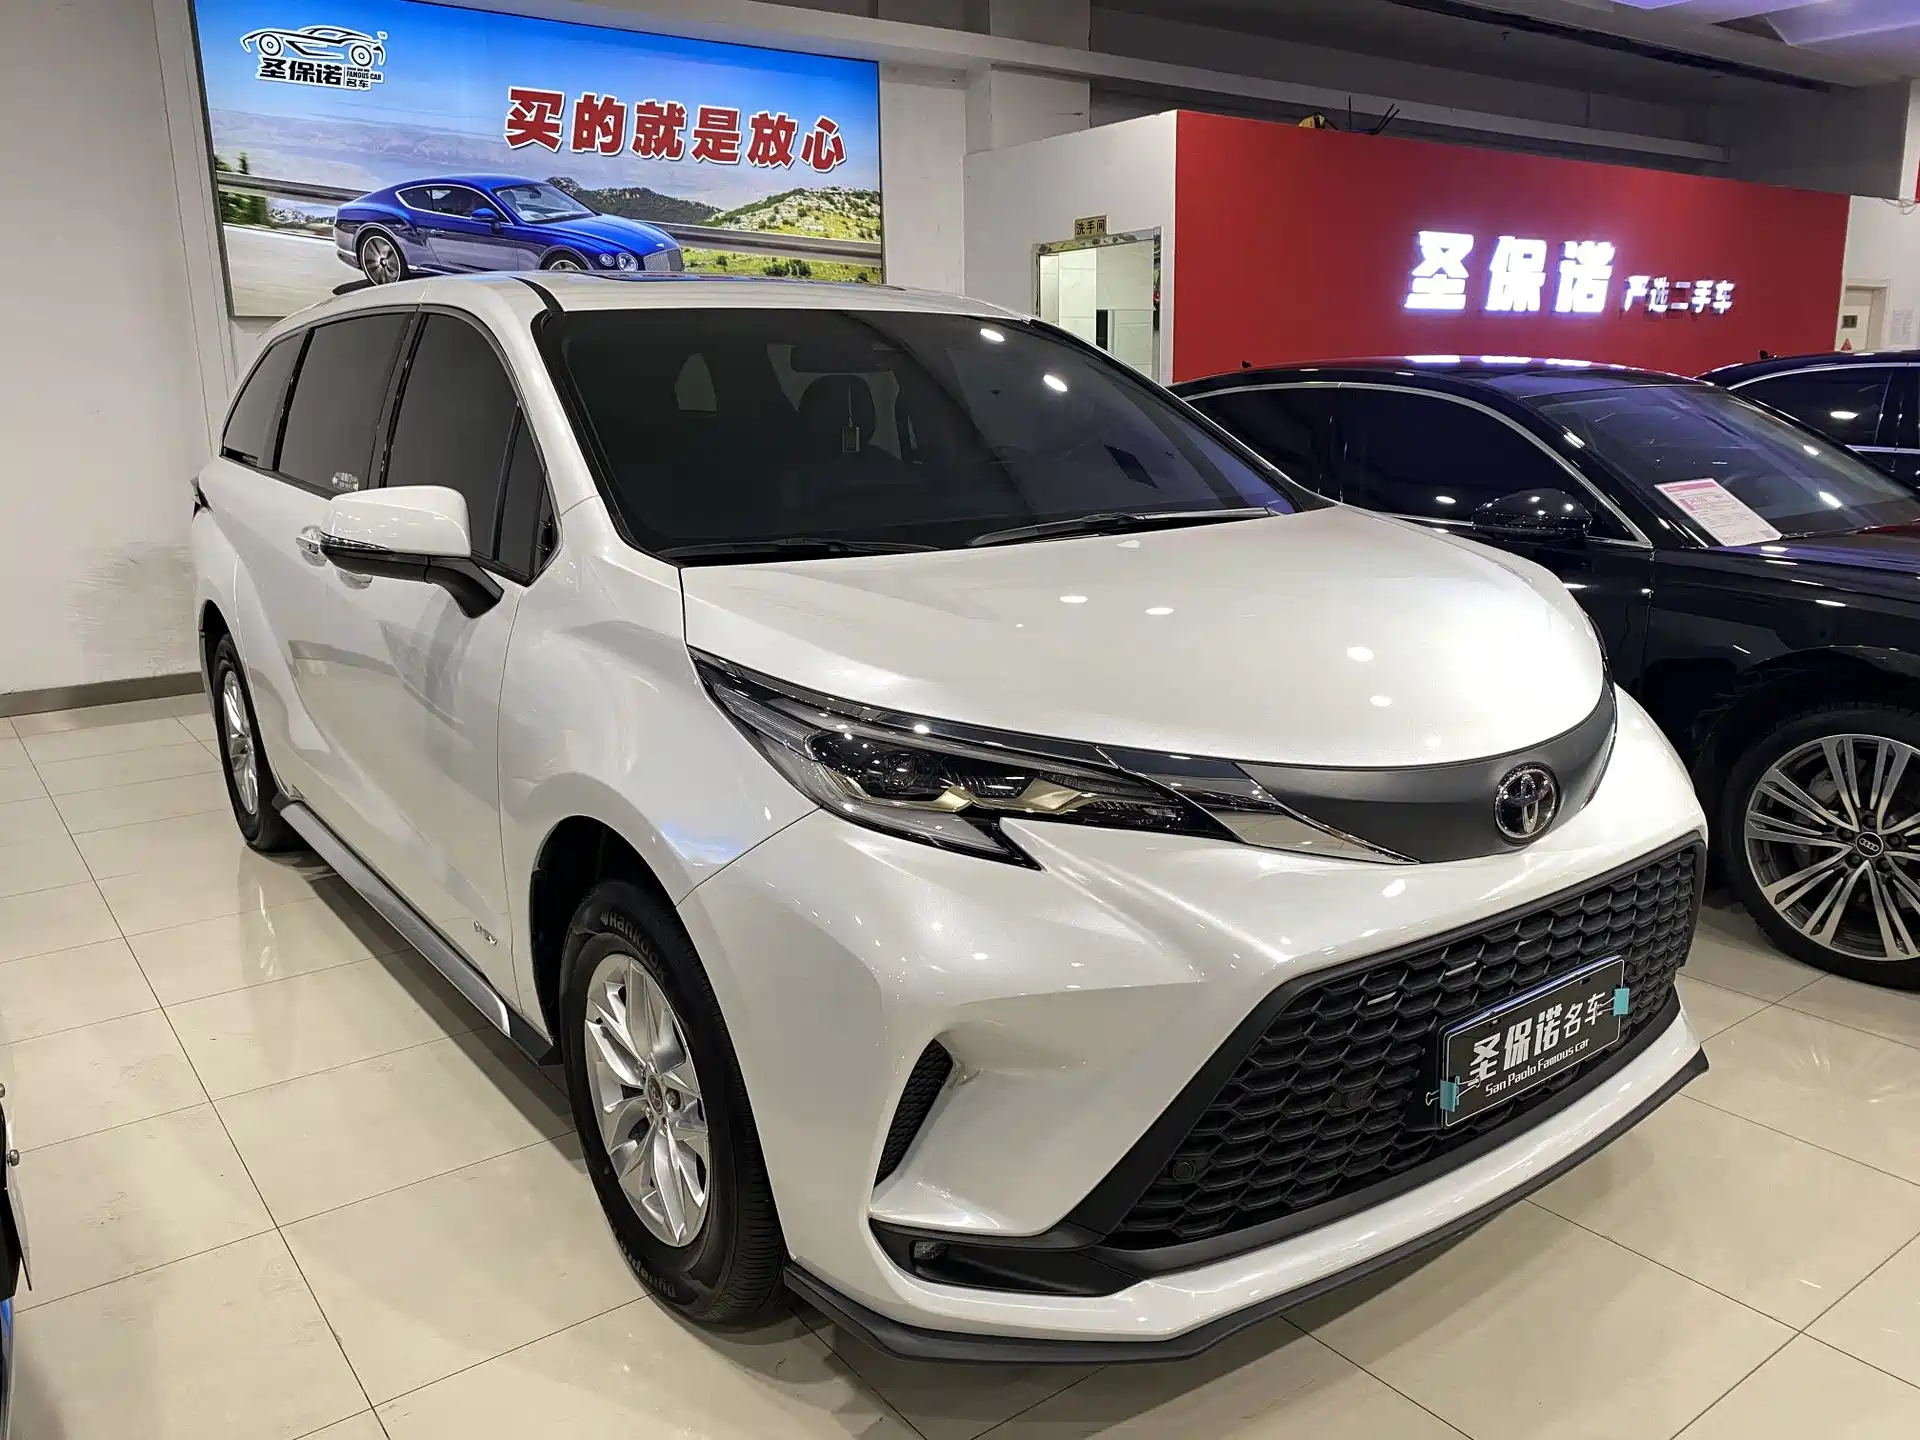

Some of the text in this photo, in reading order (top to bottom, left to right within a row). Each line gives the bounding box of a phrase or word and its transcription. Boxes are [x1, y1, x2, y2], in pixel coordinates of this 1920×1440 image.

[259, 56, 343, 86] 圣保诺
[346, 70, 382, 81] FAMOUS CAR
[346, 78, 369, 88] 名车
[503, 85, 846, 173] 买的就是放心
[1076, 219, 1105, 236] 洗手间
[1404, 230, 1736, 315] 圣保诺 严选二手车
[1467, 991, 1606, 1087] 圣保诺名车
[1485, 1038, 1590, 1098] San Paolo Famous car
